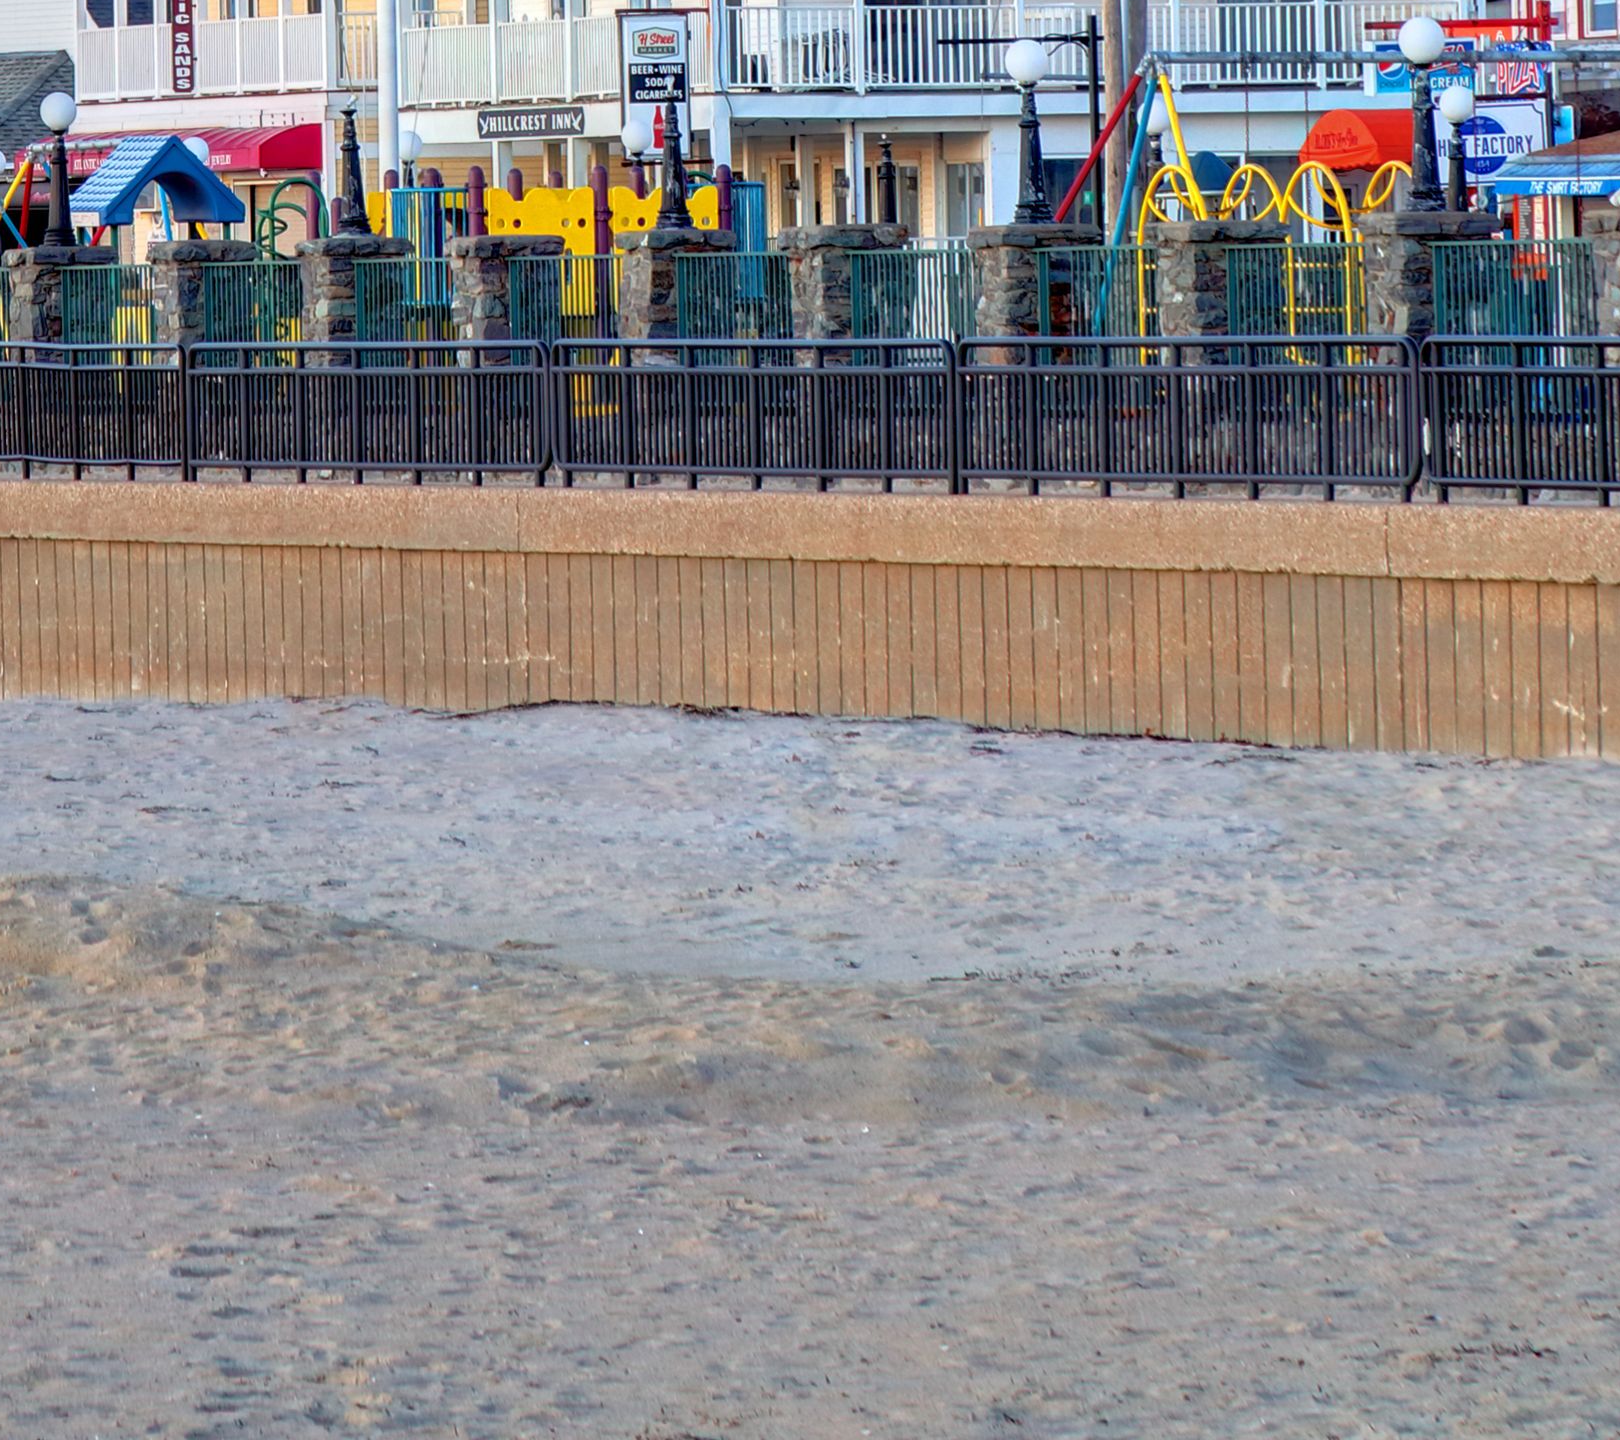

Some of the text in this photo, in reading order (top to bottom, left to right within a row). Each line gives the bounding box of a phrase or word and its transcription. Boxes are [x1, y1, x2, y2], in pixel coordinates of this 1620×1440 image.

[175, 32, 192, 90] SANDS
[1430, 76, 1470, 89] CREAM
[489, 113, 571, 132] HILLCREST INN
[1475, 134, 1533, 156] FACTORY
[1529, 181, 1543, 194] THE
